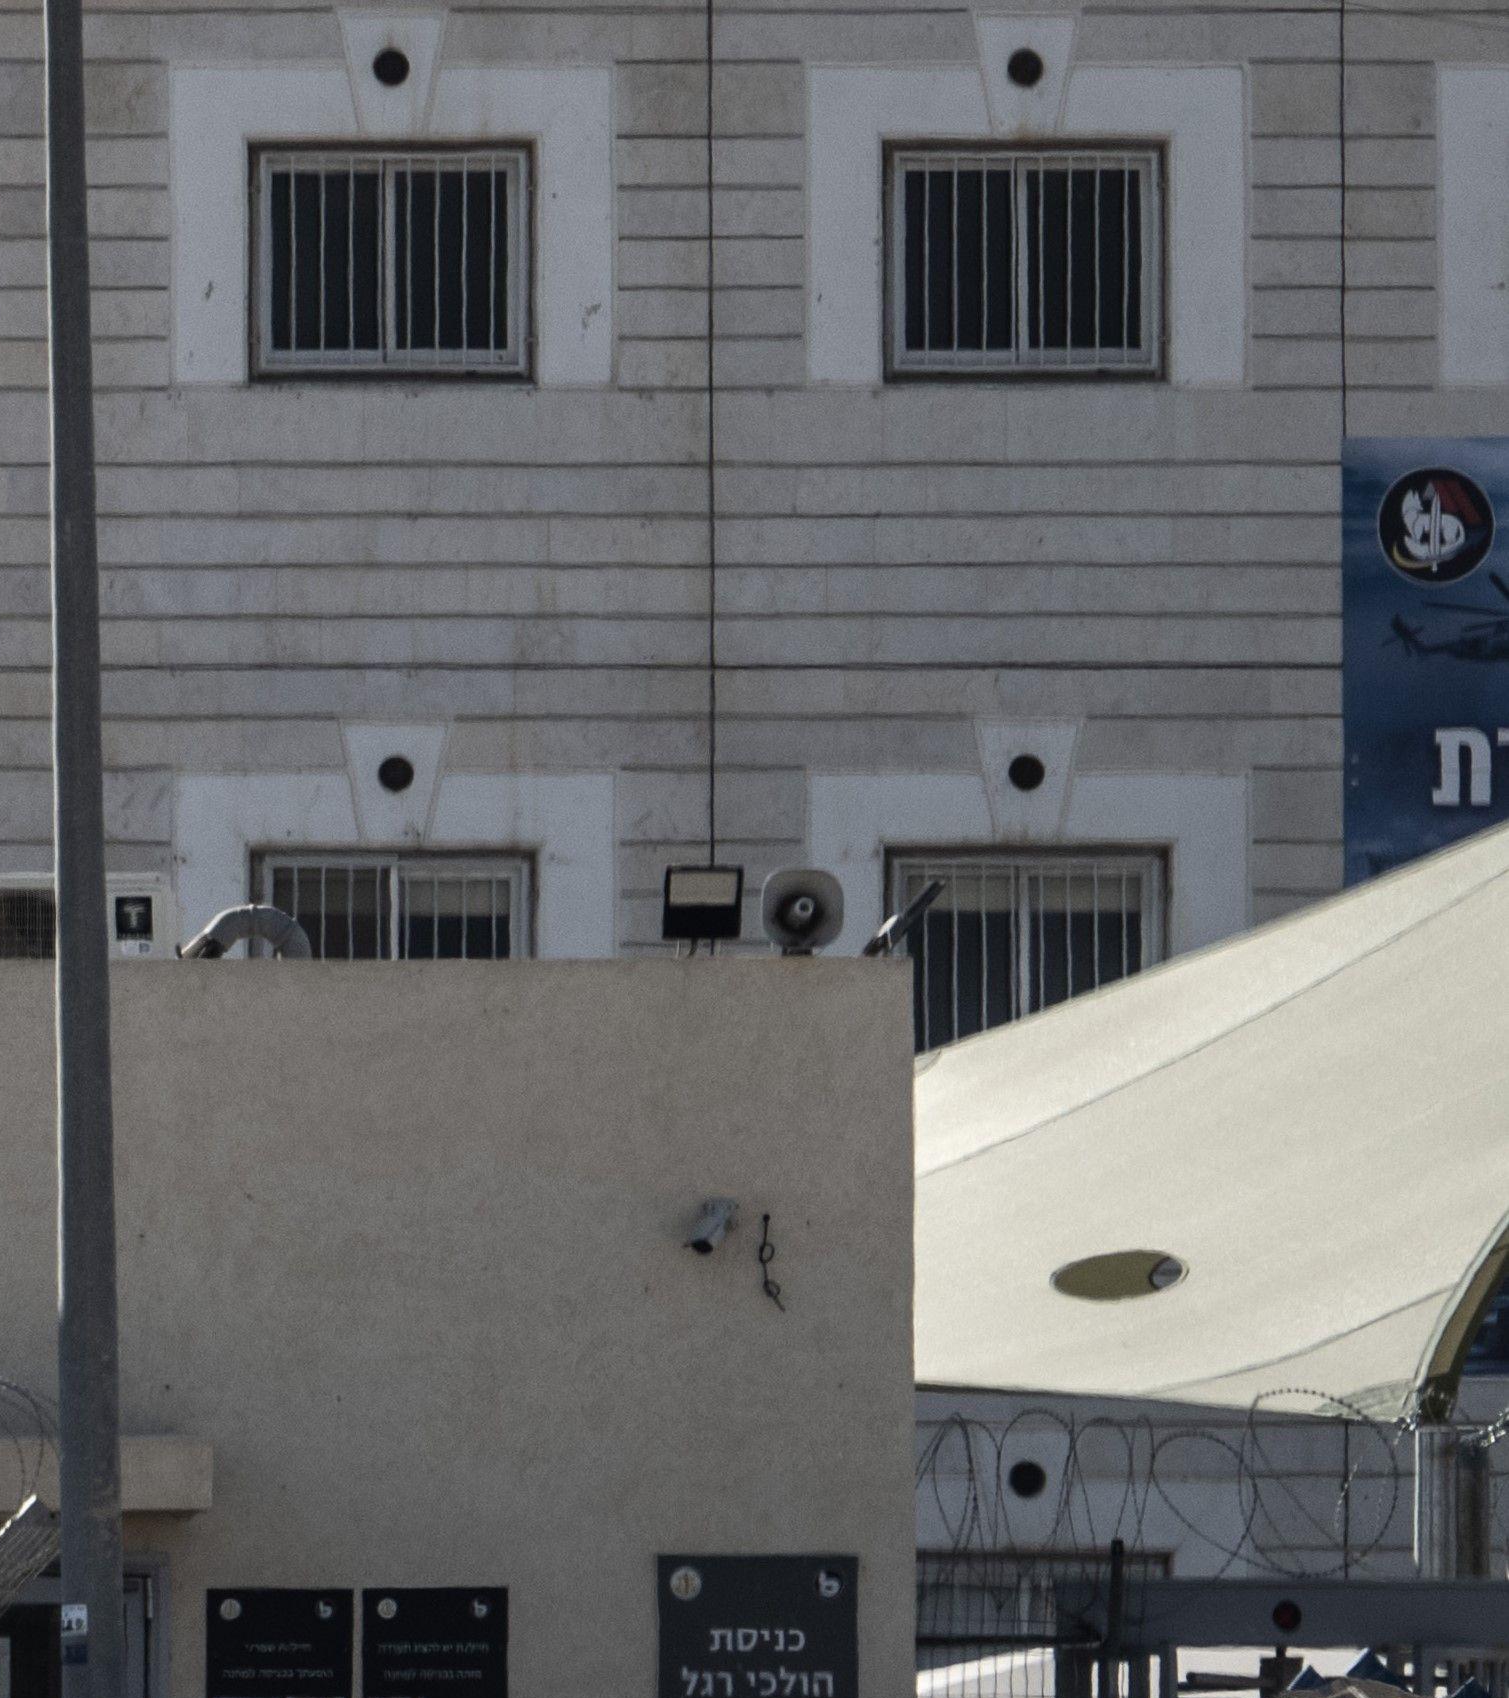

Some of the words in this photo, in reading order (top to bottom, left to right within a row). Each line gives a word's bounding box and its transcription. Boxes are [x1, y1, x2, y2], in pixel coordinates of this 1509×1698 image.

[710, 1628, 805, 1651] כניסת
[680, 1666, 734, 1698] רגל
[747, 1665, 834, 1698] הולכי
